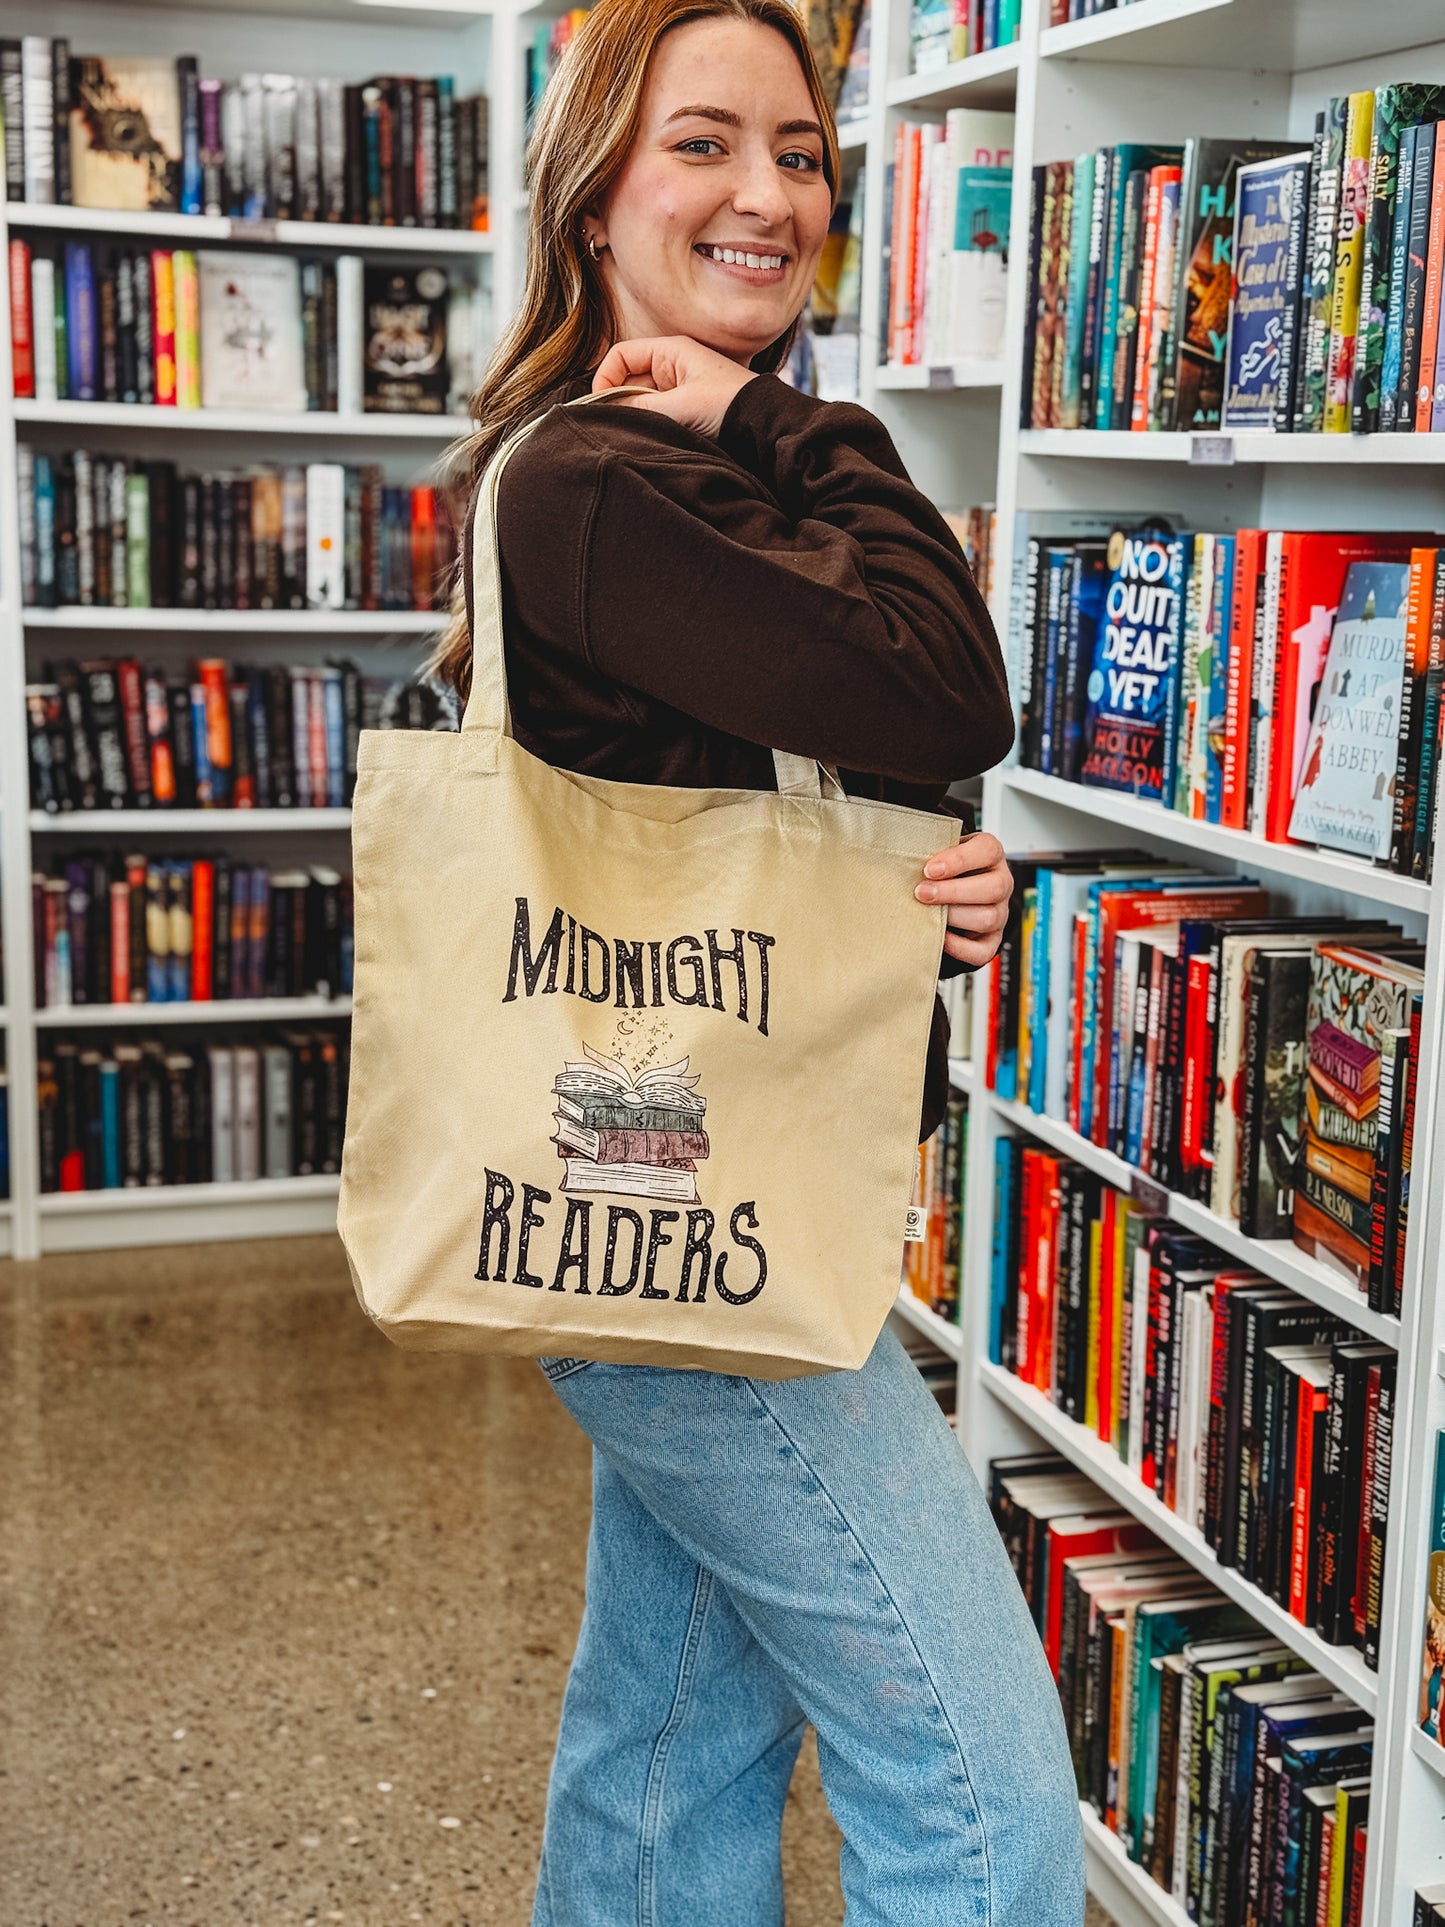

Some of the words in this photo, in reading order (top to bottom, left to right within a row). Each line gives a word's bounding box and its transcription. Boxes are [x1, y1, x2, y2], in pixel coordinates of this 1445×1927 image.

[1291, 169, 1305, 217] PAULA
[1374, 154, 1390, 201] SALLY
[1396, 148, 1407, 204] HEPWORTH
[1404, 159, 1412, 189] SALLY
[1415, 146, 1431, 200] EDWIN
[1435, 182, 1444, 201] The
[1311, 169, 1338, 287] HEIRESS
[1396, 219, 1404, 241] THE
[1411, 208, 1426, 245] HILL
[1432, 207, 1442, 250] Benefit
[1286, 219, 1300, 291] HAWKINS
[1365, 242, 1373, 260] THE
[1334, 276, 1345, 328] RACHEL
[1359, 263, 1373, 331] YOUNGER
[1388, 245, 1406, 333] SOULMATE
[1408, 277, 1419, 309] WHO
[1426, 270, 1439, 329] Hindsight
[1282, 303, 1294, 330] THE
[1279, 332, 1292, 365] BLUE
[1312, 319, 1326, 372] RACHEL
[1329, 334, 1340, 397] HAWKINS
[1356, 334, 1367, 371] WIFE
[1277, 368, 1289, 408] HOUR
[1236, 548, 1244, 594] ANGIE
[1408, 562, 1423, 625] WILLIAM
[1433, 562, 1445, 630] APOSTLE'S
[1233, 604, 1241, 632] KIM
[1102, 624, 1171, 671] DEAD
[1405, 632, 1416, 669] KENT
[1430, 634, 1441, 667] COVE
[1108, 668, 1159, 714] YET
[1226, 645, 1241, 737] HAPPINESS
[1355, 673, 1385, 698] AT
[1399, 676, 1414, 741] KRUEGER
[1424, 686, 1438, 739] WILLIAM
[1095, 728, 1154, 759] HOLLY
[1324, 743, 1384, 774] ABBEY
[1422, 743, 1433, 775] KENT
[1082, 752, 1163, 789] JACKSON
[1224, 744, 1237, 794] FALLS
[1396, 756, 1408, 782] FOX
[1393, 788, 1405, 832] CREEK
[1417, 778, 1431, 834] KRUEGER
[501, 896, 776, 1037] MIDNIGHT
[1206, 973, 1218, 1023] ISLAND
[1247, 1020, 1256, 1062] GOD
[1378, 1055, 1394, 1135] DROWNING
[1318, 1106, 1378, 1151] MURDER
[1242, 1121, 1253, 1188] WOODS
[1072, 1192, 1084, 1225] THE
[1323, 1184, 1353, 1228] NELSON
[474, 1166, 767, 1305] READERS
[1370, 1202, 1386, 1267] NEWMAN
[1070, 1227, 1083, 1309] PRISONER
[1244, 1314, 1257, 1354] KARIN
[1242, 1356, 1255, 1428] SLAUGHTER
[1334, 1373, 1345, 1401] WE
[1379, 1389, 1390, 1411] THE
[1263, 1385, 1274, 1437] PRETTY
[1332, 1402, 1343, 1440] ARE
[1367, 1406, 1378, 1448] Talent
[1240, 1446, 1251, 1487] AFTER
[1261, 1440, 1271, 1483] GIRLS
[1329, 1441, 1341, 1475] ALL
[1366, 1451, 1376, 1474] for
[1372, 1412, 1392, 1522] HITCHHIKERS
[1238, 1489, 1250, 1519] THAT
[1296, 1513, 1304, 1524] IS
[1297, 1487, 1305, 1511] THIS
[1363, 1478, 1374, 1533] Murder
[1236, 1521, 1249, 1561] NIGHT
[1295, 1527, 1304, 1551] WHY
[1323, 1531, 1335, 1586] KARIN
[1370, 1535, 1382, 1573] CHEVY
[1294, 1553, 1303, 1570] WE
[1293, 1571, 1302, 1598] LIED
[1367, 1576, 1380, 1628] STEVENS
[1256, 1719, 1268, 1762] ONLY
[1255, 1765, 1265, 1783] IF
[1252, 1786, 1264, 1845] YOU'RE
[1277, 1772, 1291, 1846] FORGET
[1275, 1849, 1285, 1877] ME
[1320, 1823, 1331, 1875] KAREN
[1249, 1846, 1260, 1899] LUCKY
[1273, 1882, 1284, 1922] NOT
[1316, 1878, 1328, 1927] WHITE
